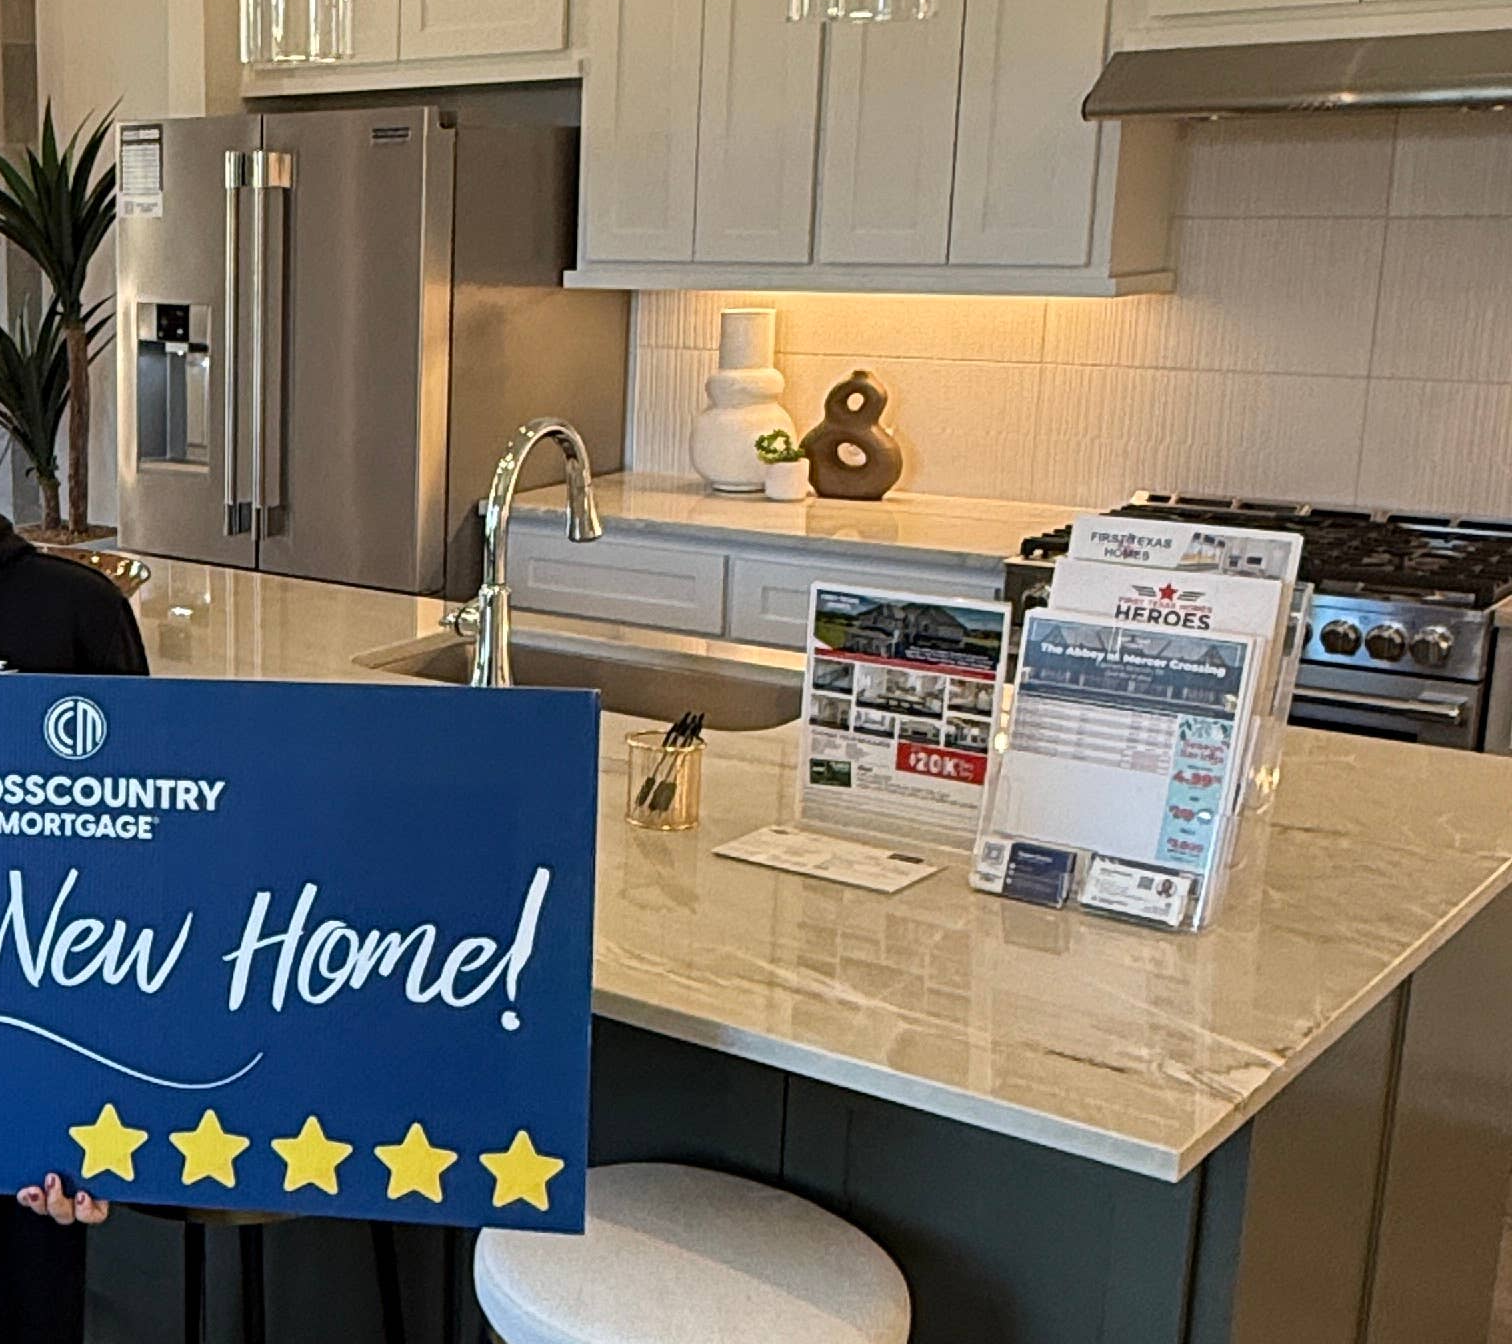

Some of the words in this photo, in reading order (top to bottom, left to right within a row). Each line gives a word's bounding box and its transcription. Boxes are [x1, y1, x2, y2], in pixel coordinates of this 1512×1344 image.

[1114, 604, 1211, 630] HEROES
[1040, 642, 1064, 655] The
[1169, 657, 1227, 678] Crossing
[223, 866, 551, 1032] Home!
